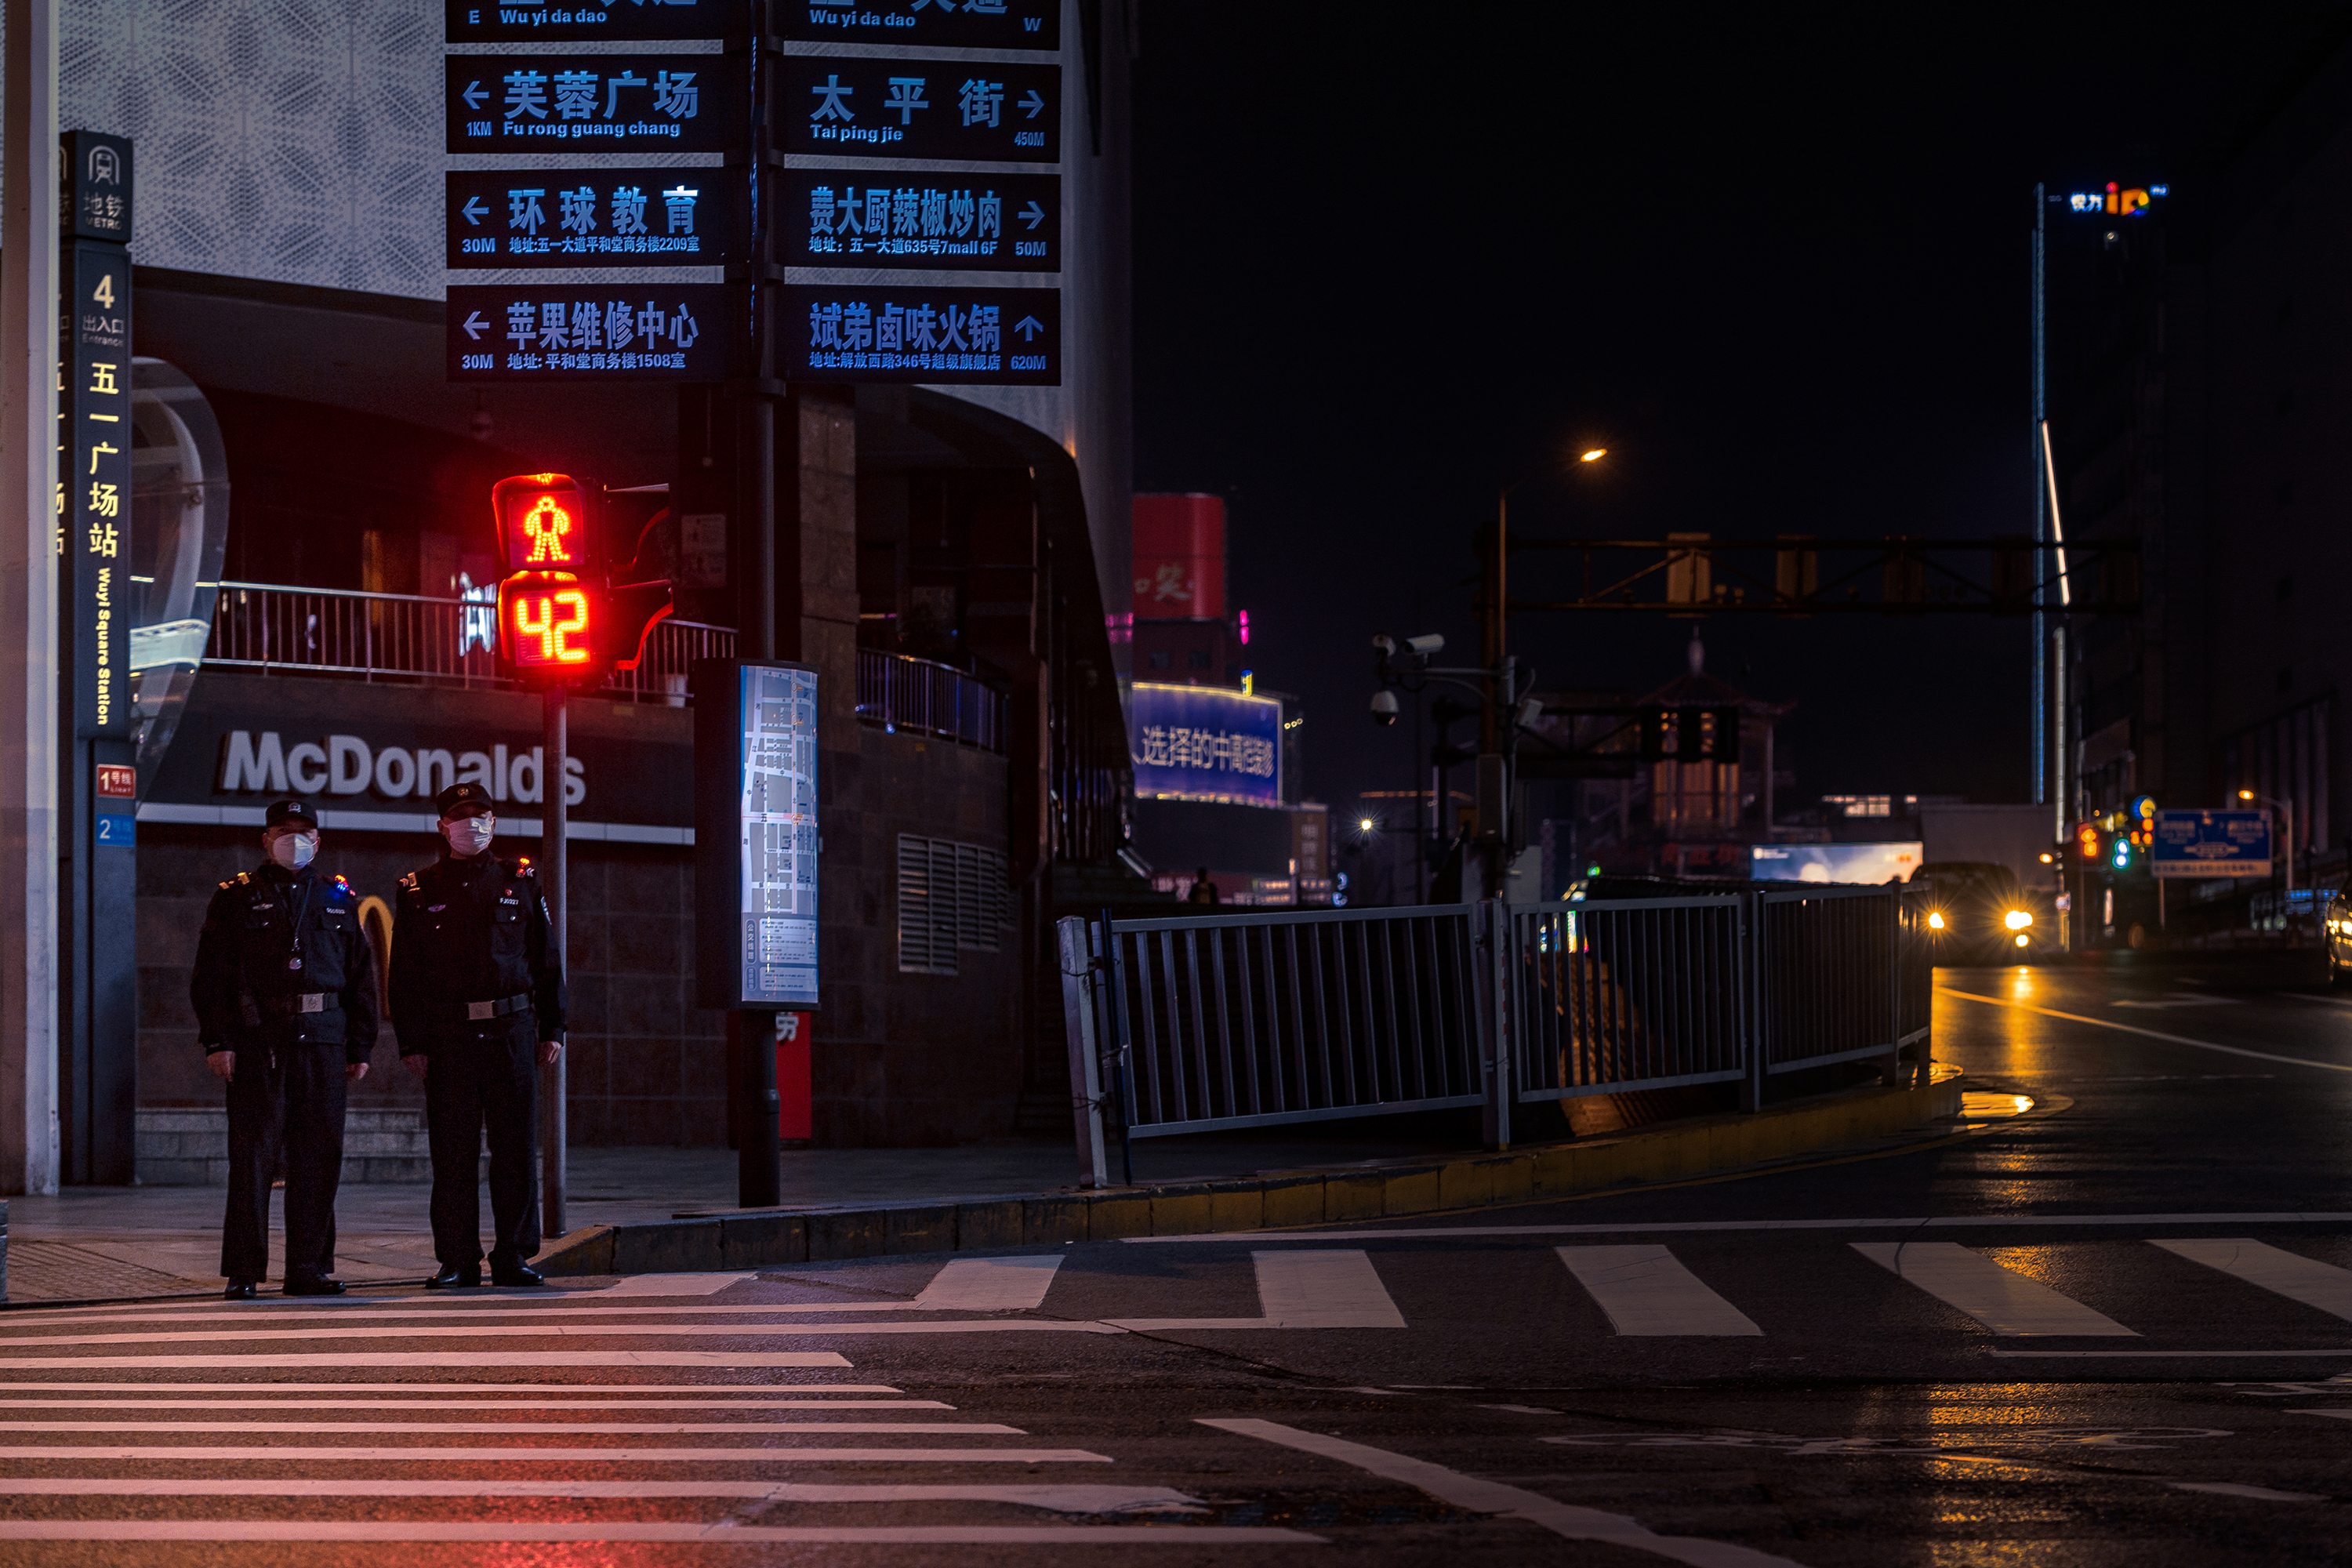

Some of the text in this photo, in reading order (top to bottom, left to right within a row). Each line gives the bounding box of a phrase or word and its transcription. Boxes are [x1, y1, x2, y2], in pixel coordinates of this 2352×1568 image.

[468, 9, 480, 24] E
[499, 9, 608, 27] Wu yi da dao
[809, 9, 916, 27] Wu yi da dao
[1022, 17, 1042, 32] W
[503, 70, 699, 119] 芙蓉广场
[810, 74, 1005, 129] 太平街
[466, 122, 492, 136] 1KM
[503, 121, 681, 139] Fu rong guang chang
[810, 124, 904, 143] Tai ping jie
[1014, 132, 1045, 147] 450M
[83, 191, 125, 218] 地铁
[507, 185, 699, 234] 环球教育
[809, 186, 1002, 238] 费大厨辣椒炒肉
[462, 238, 496, 253] 30M
[1014, 241, 1047, 256] 50M
[93, 274, 115, 309] 4
[82, 314, 124, 334] 出入口
[506, 300, 699, 350] 苹果维修中心
[809, 301, 1001, 352] 斌弟卤味火锅
[462, 354, 494, 369] 30M
[1011, 355, 1047, 371] 620M
[88, 361, 120, 558] 五一广场站
[514, 591, 588, 662] 42
[96, 568, 111, 725] Wuyi Square Station
[100, 819, 111, 840] 2
